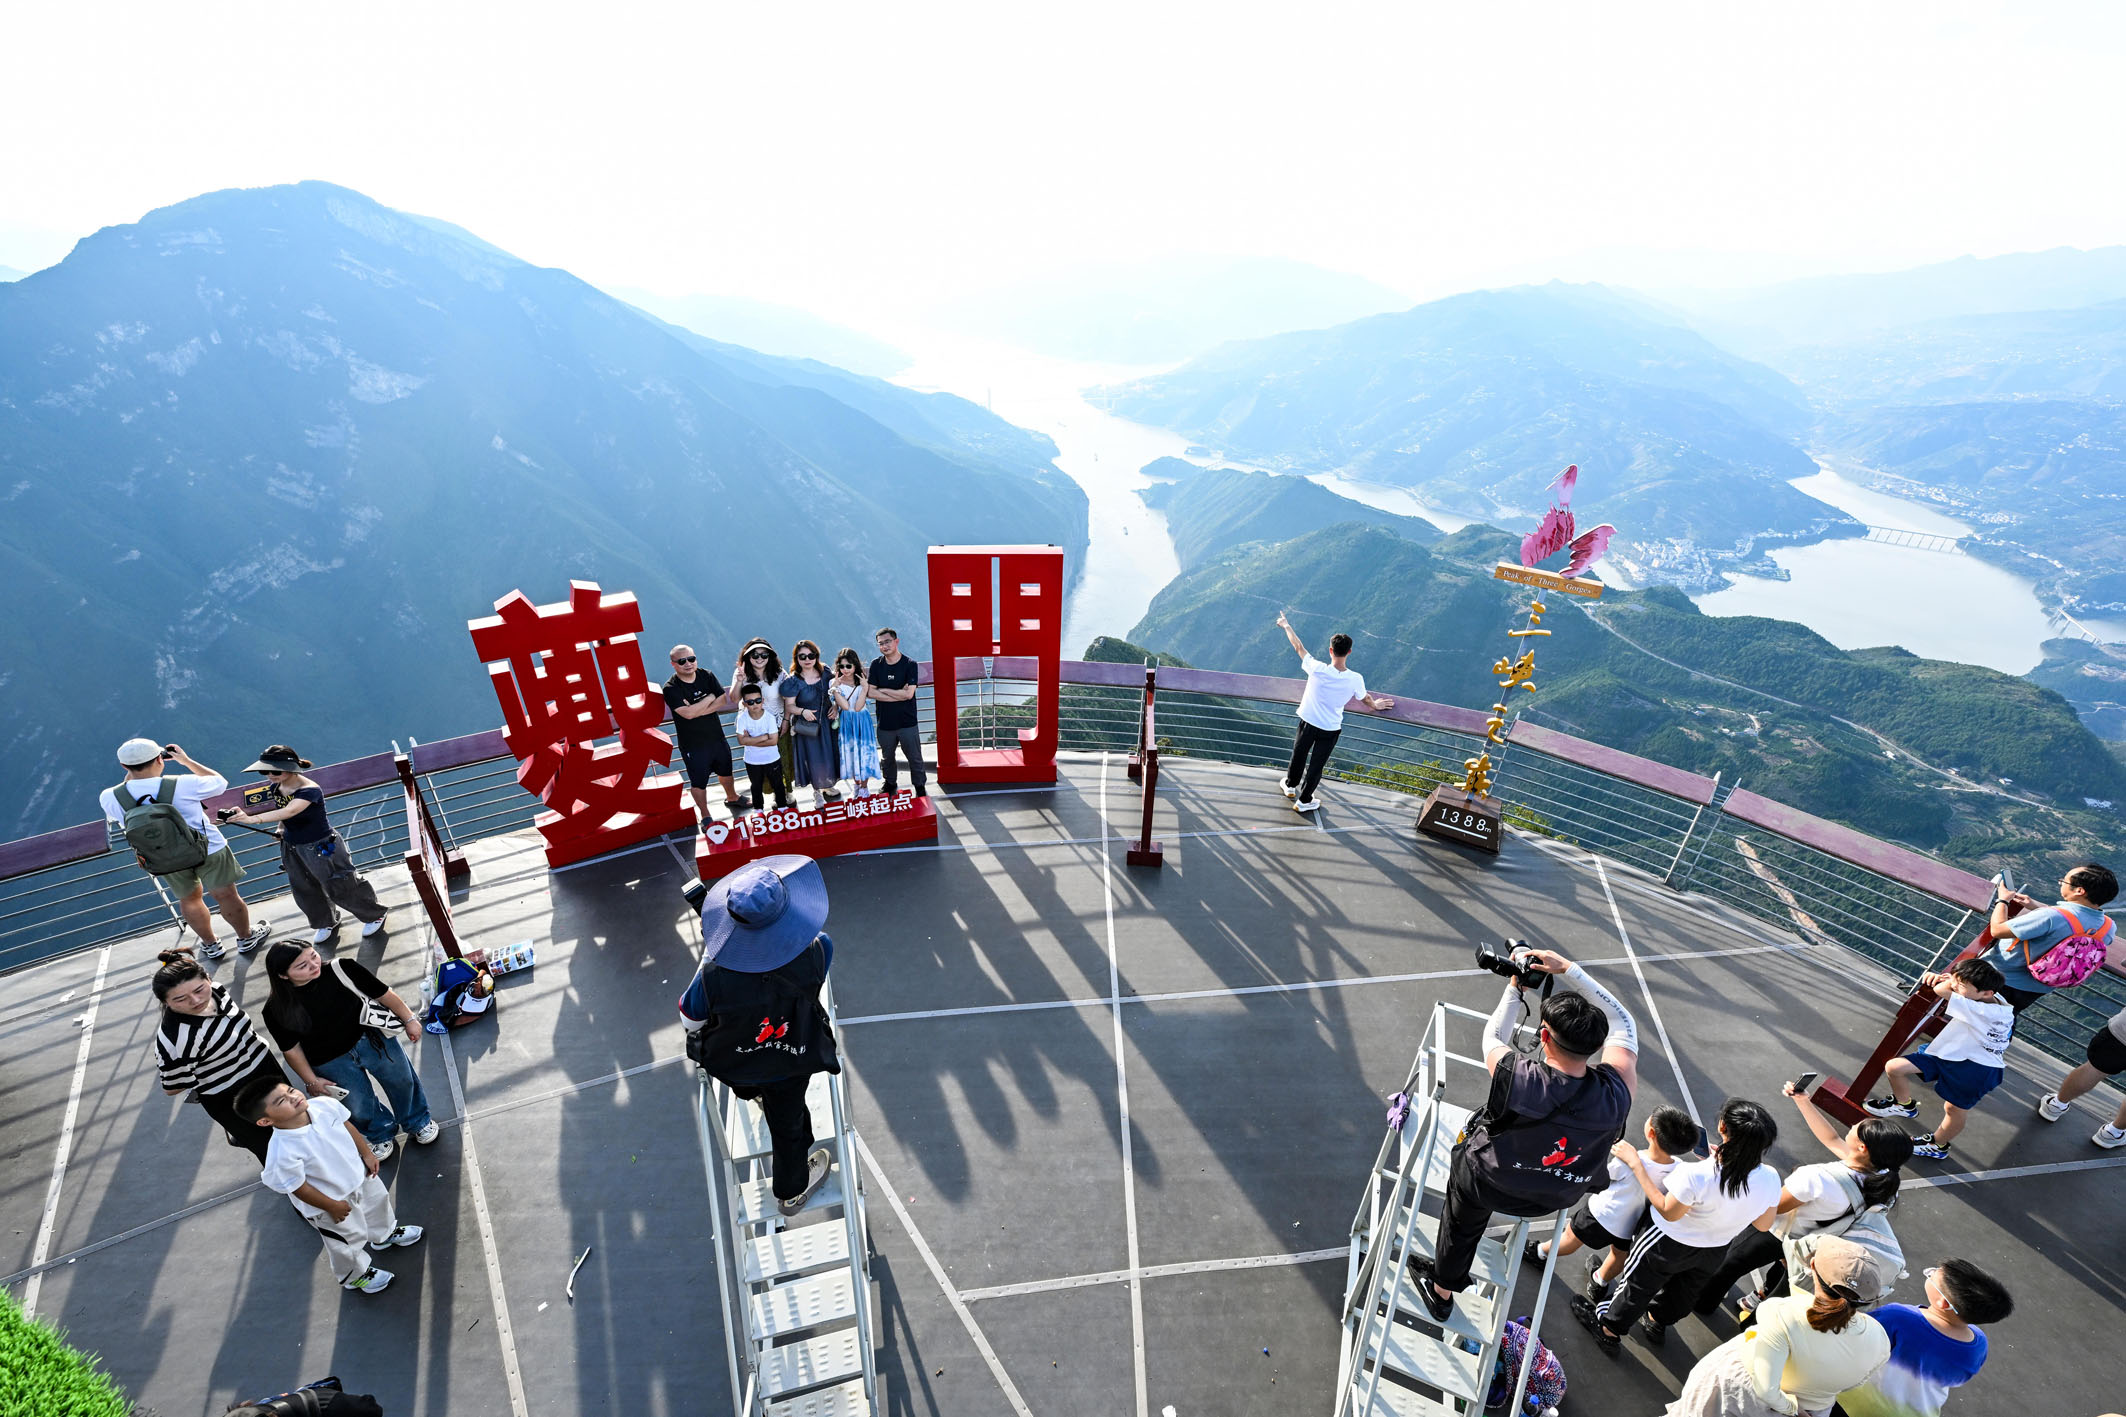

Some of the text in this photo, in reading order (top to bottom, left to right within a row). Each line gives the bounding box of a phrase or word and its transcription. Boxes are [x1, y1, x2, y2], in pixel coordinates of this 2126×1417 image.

[1503, 570, 1519, 579] Peak
[1539, 578, 1559, 587] Three
[1566, 583, 1592, 594] Gorges
[733, 792, 914, 841] 1388m三峡起点
[1441, 807, 1492, 834] 1388m
[1595, 989, 1635, 1039] RUBICON
